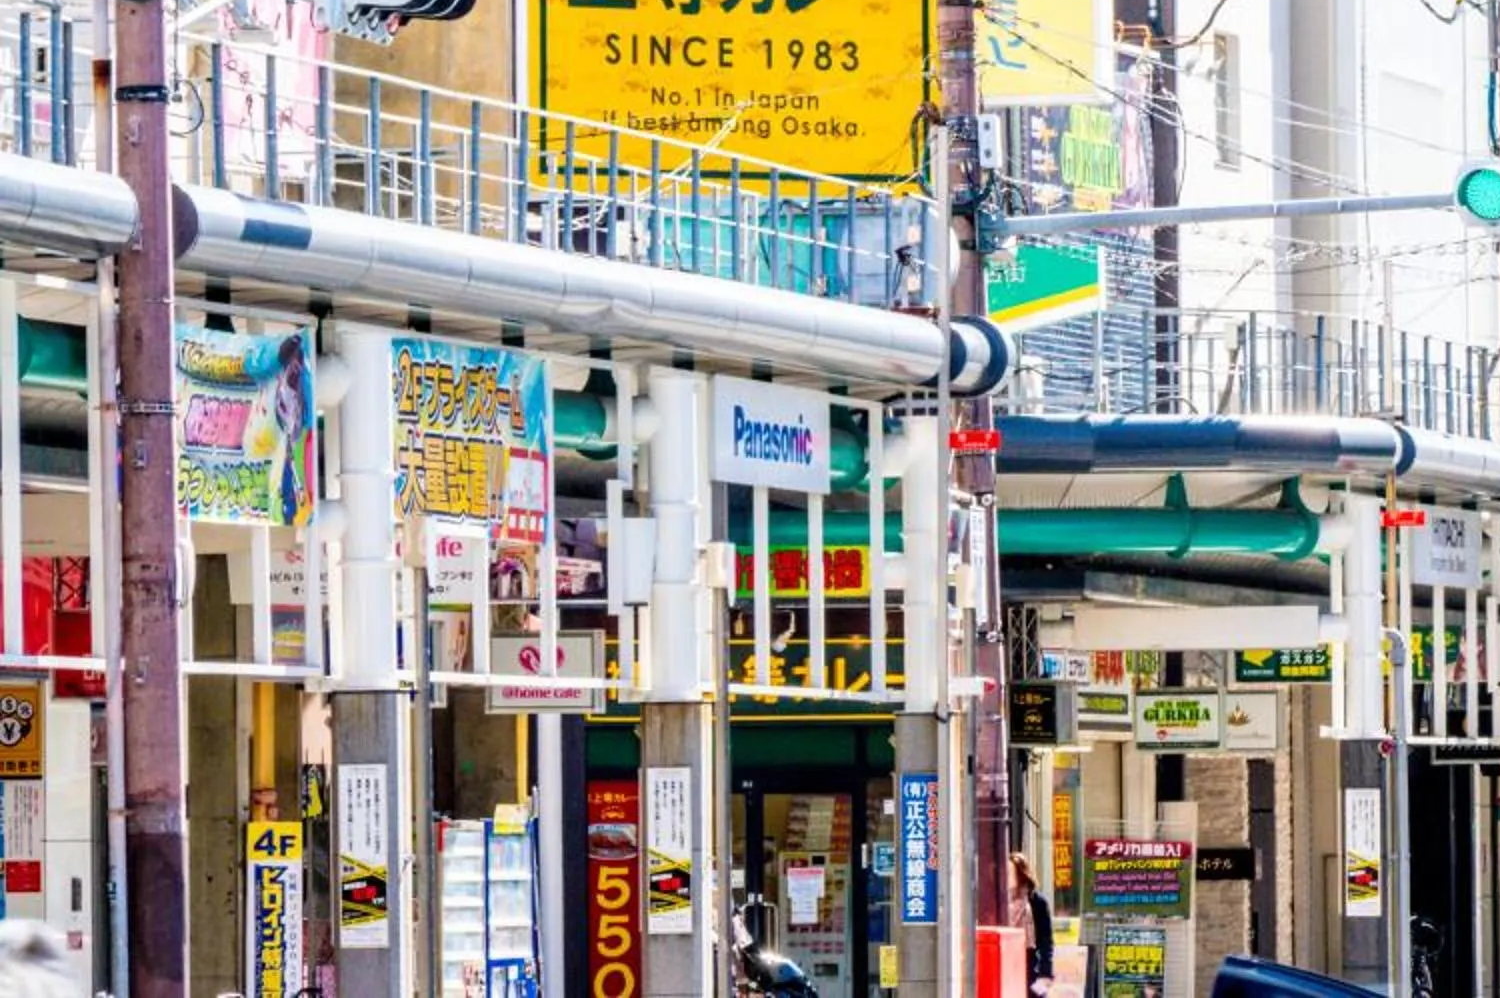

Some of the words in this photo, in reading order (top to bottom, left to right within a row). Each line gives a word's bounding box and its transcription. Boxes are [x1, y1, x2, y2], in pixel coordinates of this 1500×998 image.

[604, 33, 735, 68] SINCE
[764, 39, 860, 72] 1983
[733, 404, 813, 466] Panasonic
[1143, 706, 1212, 723] GURKHA
[253, 828, 296, 856] 4F
